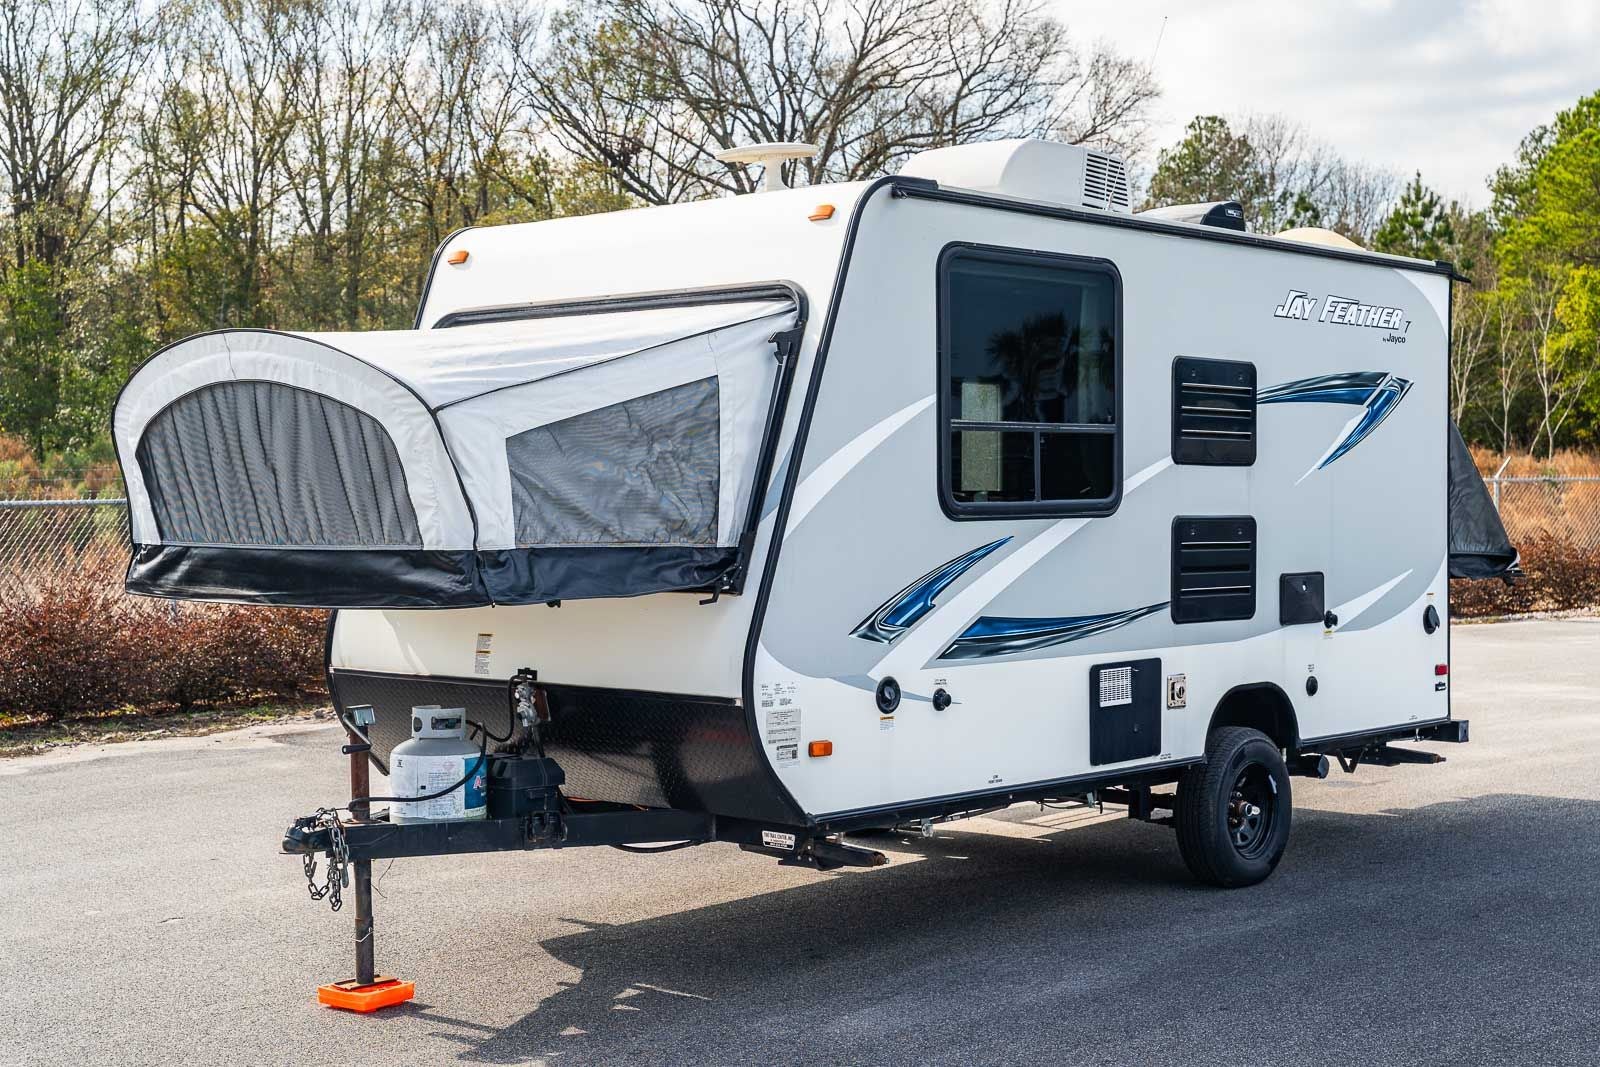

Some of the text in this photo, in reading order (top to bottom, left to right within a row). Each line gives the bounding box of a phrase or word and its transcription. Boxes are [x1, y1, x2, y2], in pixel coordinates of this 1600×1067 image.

[1274, 290, 1318, 320] JAY
[1318, 294, 1404, 330] FEATHER
[1387, 332, 1406, 345] Jayco
